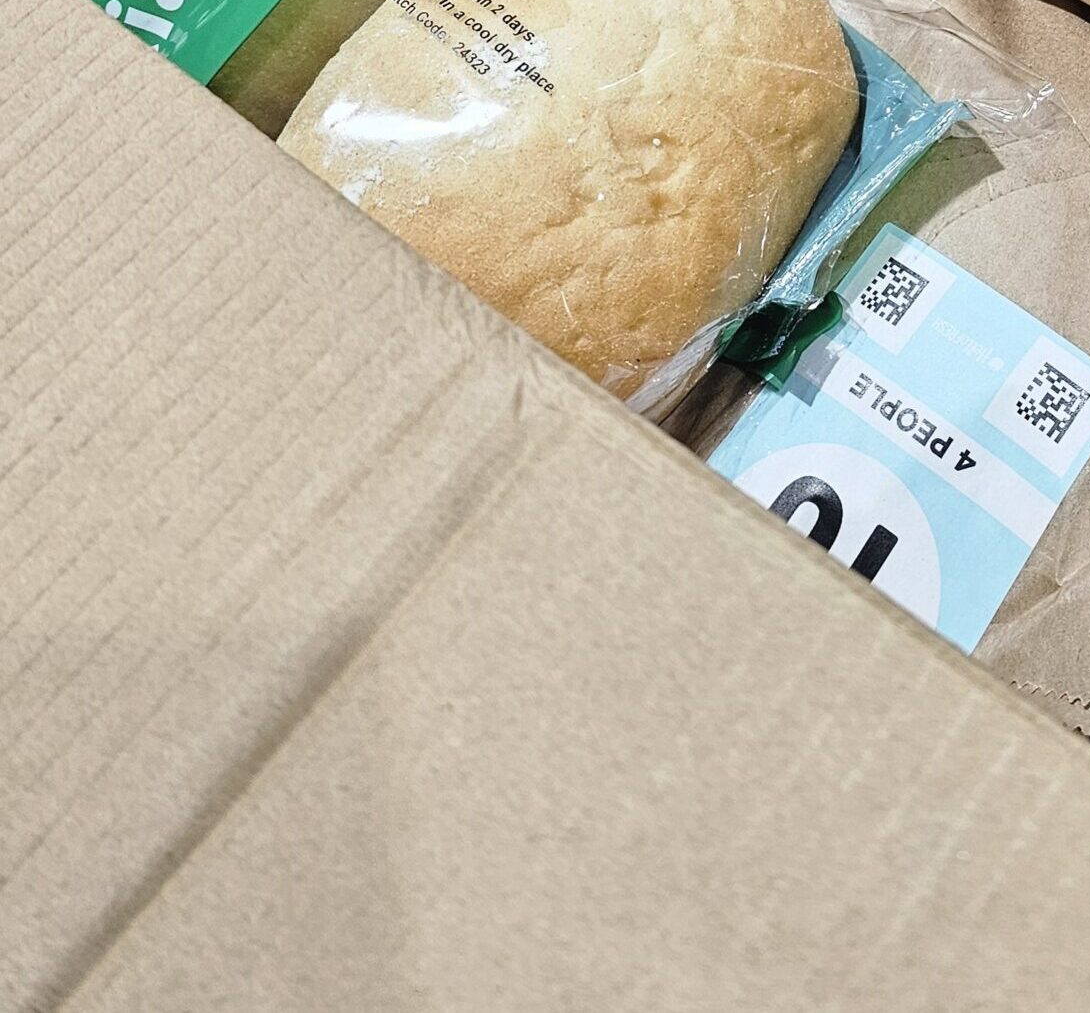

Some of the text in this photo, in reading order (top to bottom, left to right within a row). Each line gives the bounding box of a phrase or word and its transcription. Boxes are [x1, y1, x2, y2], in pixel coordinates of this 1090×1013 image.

[453, 10, 466, 20] a
[464, 17, 497, 43] cool
[494, 41, 518, 64] dry
[514, 61, 555, 96] place.
[491, 4, 505, 15] 2
[502, 13, 536, 45] days.
[452, 42, 491, 75] 24323
[849, 372, 977, 471] 4 PEOPLE
